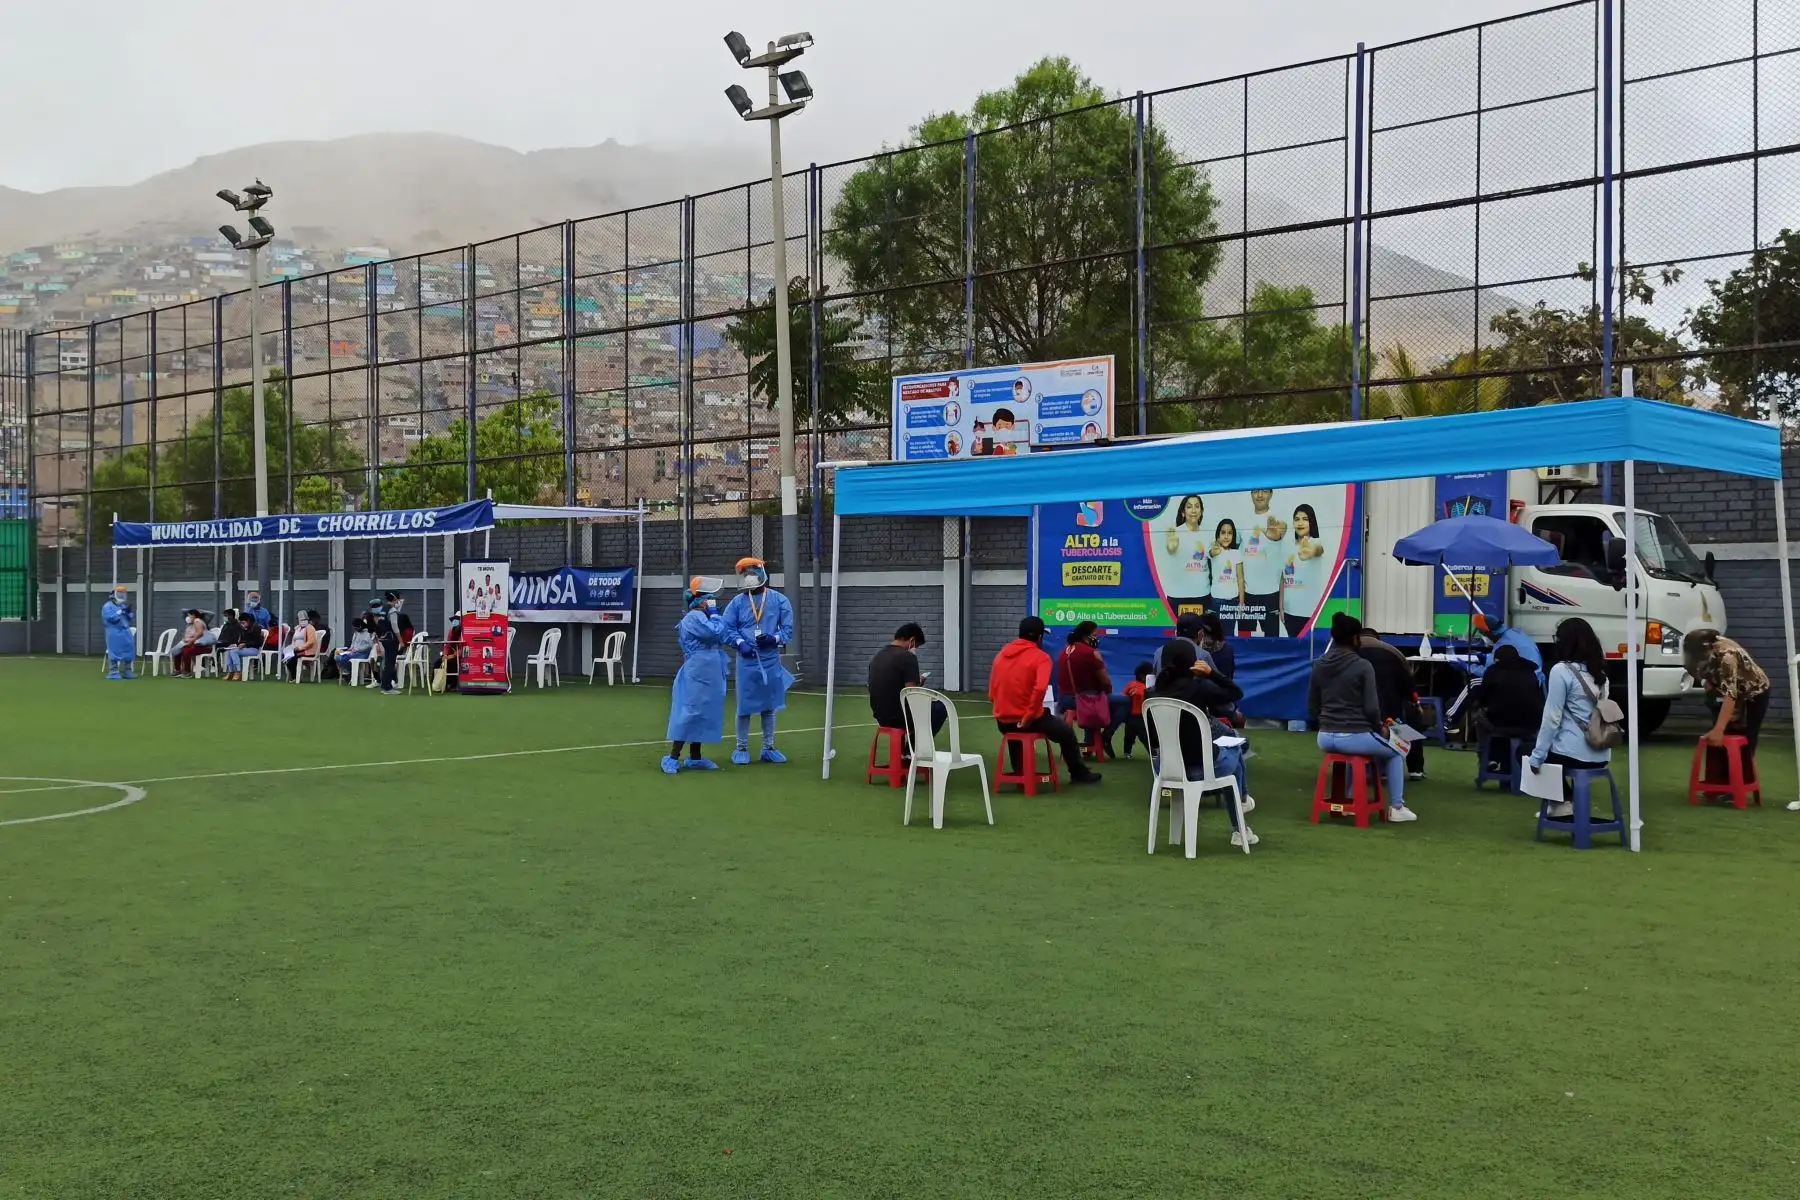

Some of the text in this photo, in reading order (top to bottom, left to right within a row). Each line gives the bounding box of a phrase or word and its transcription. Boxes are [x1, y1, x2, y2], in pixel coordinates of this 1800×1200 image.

[151, 511, 438, 541] MUNICIPALIDAD DE CHORRILLOS
[1064, 533, 1118, 548] ALTO a la
[1060, 547, 1122, 557] TUBERCULOSIS
[1072, 565, 1112, 574] DESCARTE
[588, 577, 621, 586] DE TODOS
[1250, 605, 1266, 614] para
[1076, 612, 1091, 620] Alto
[1104, 612, 1148, 620] Tuberculosis
[1219, 612, 1234, 620] toda
